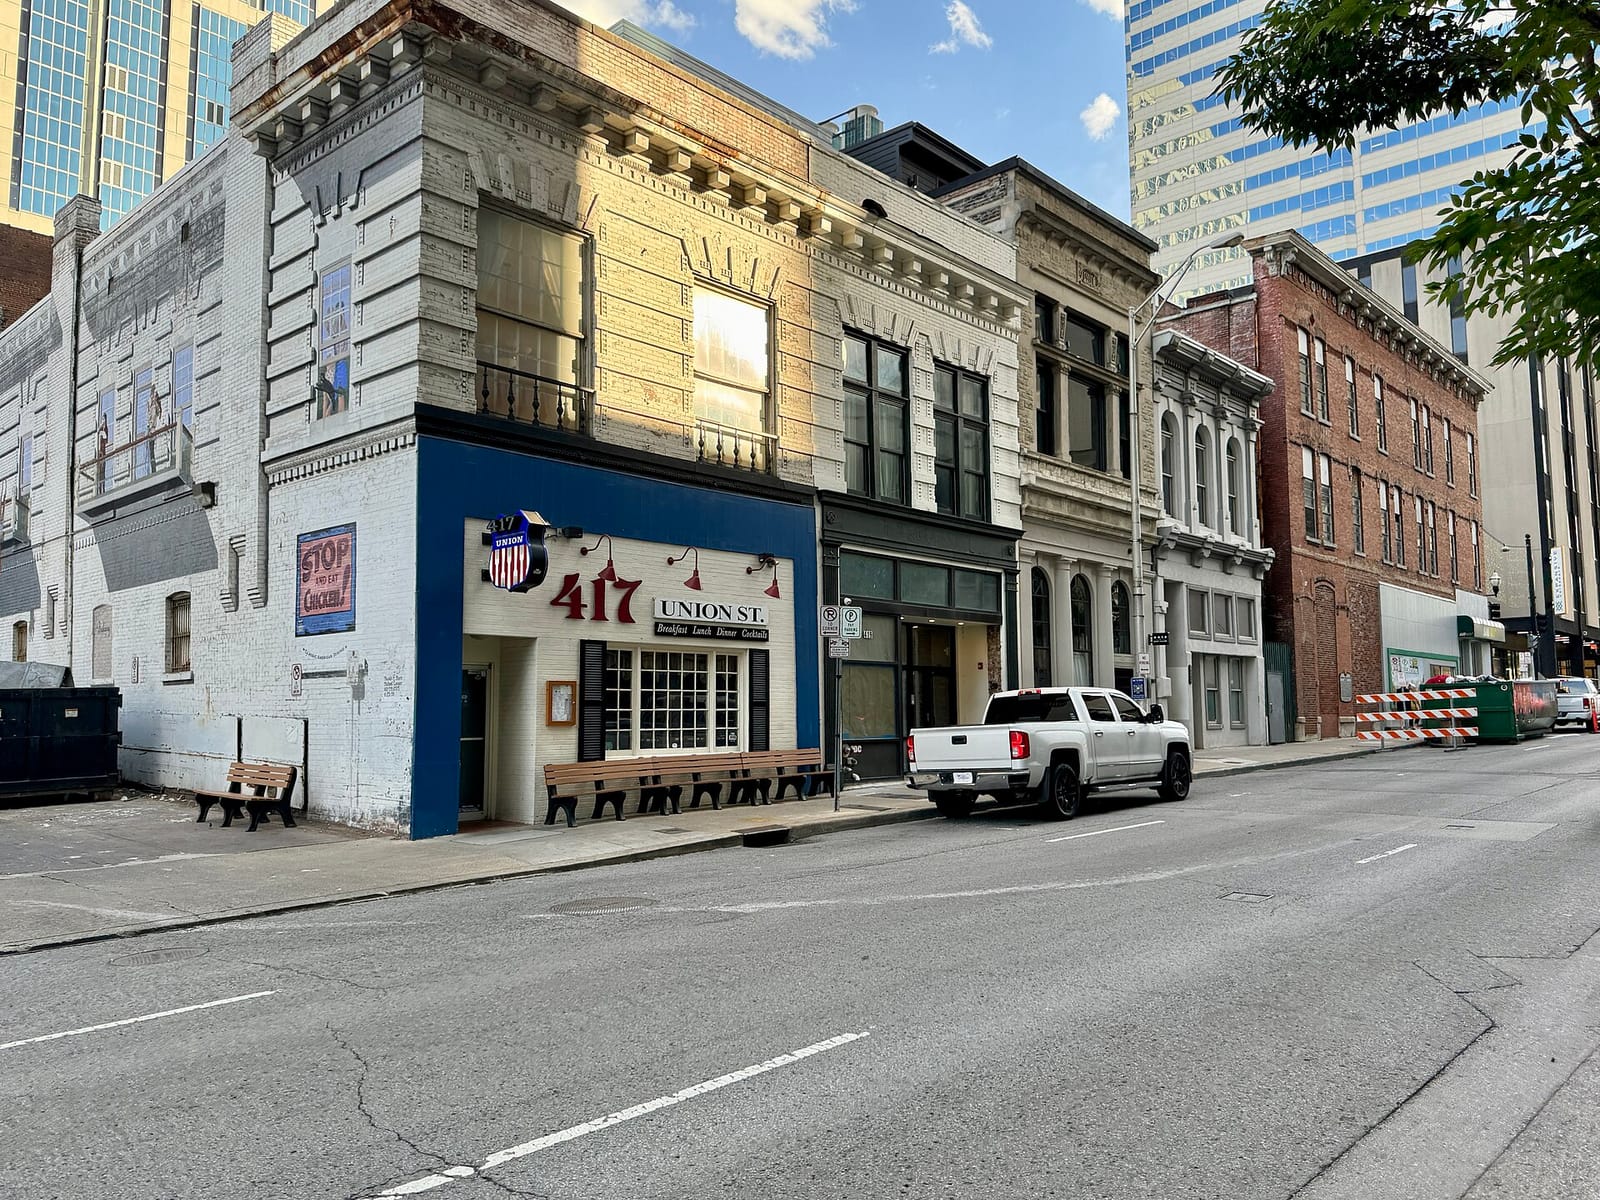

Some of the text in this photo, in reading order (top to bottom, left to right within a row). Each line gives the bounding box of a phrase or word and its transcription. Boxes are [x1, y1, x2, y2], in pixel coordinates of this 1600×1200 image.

[487, 516, 514, 532] 417
[495, 535, 523, 547] UNION
[302, 538, 349, 583] STOP
[315, 573, 339, 585] AND EAT
[550, 572, 643, 624] 417
[660, 599, 765, 623] UNION ST.
[657, 624, 768, 640] Breakfast Lunch Dinner Cocktails
